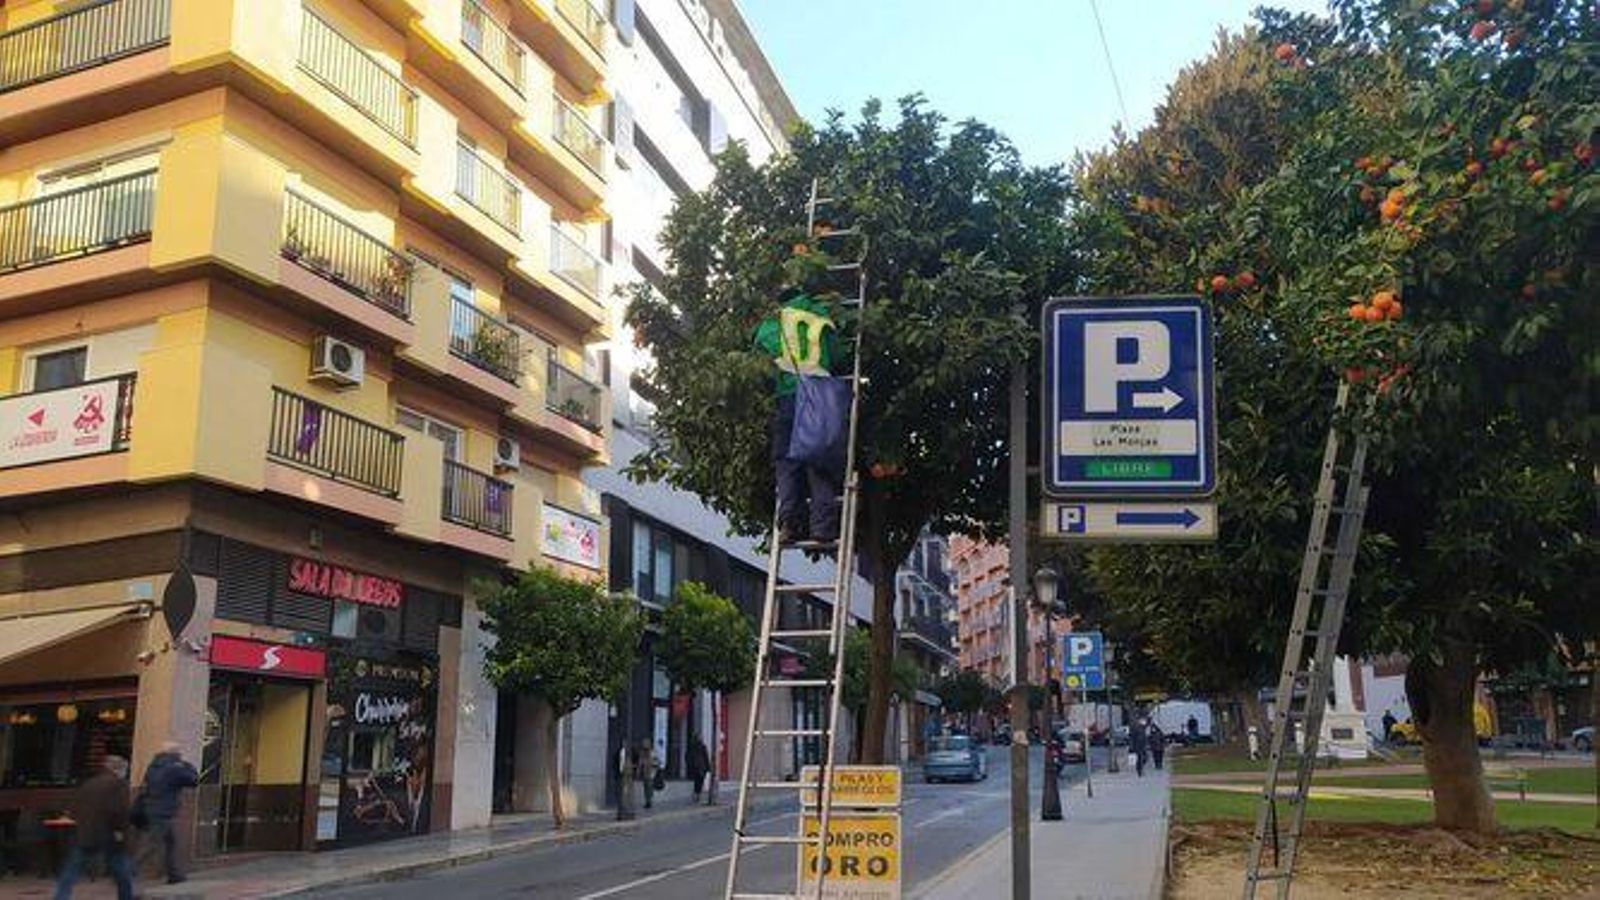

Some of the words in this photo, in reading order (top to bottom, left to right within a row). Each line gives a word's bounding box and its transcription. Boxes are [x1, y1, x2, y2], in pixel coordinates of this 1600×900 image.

[1085, 320, 1170, 413] P
[1093, 438, 1113, 447] Las
[1060, 507, 1081, 531] P
[288, 558, 330, 596] SALA
[1070, 636, 1093, 665] P
[811, 855, 889, 877] ORO
